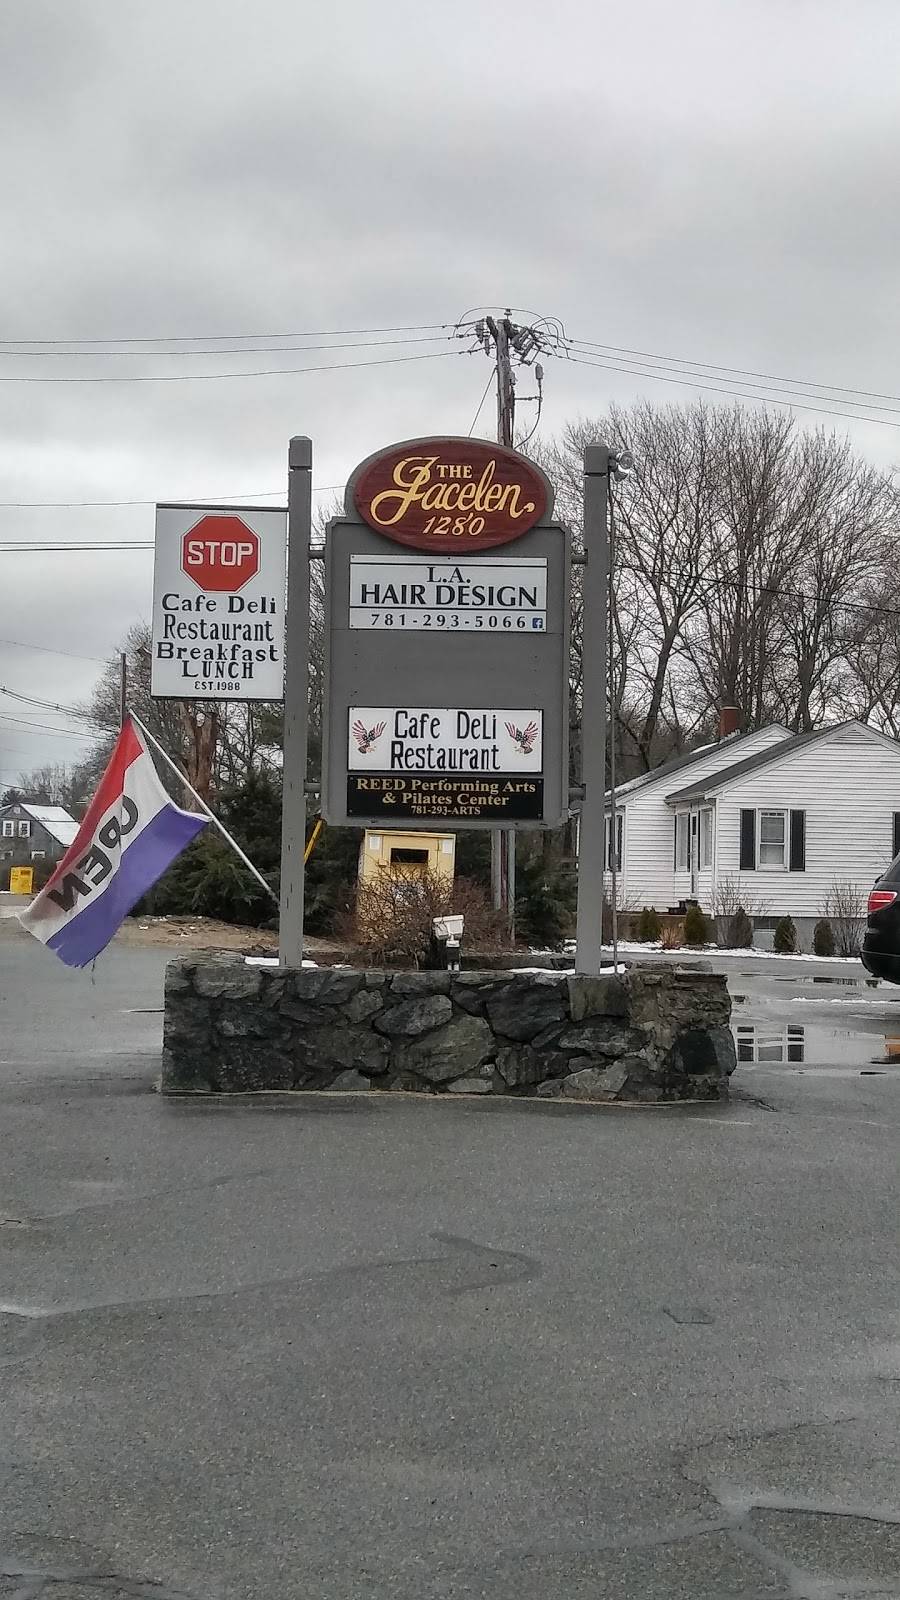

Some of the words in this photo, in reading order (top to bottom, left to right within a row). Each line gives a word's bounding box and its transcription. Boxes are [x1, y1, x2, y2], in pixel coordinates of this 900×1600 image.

[436, 464, 473, 479] THE
[423, 512, 485, 536] 1280
[187, 540, 254, 566] STOP
[426, 566, 471, 583] L.A.
[162, 593, 217, 612] Cafe
[228, 595, 276, 614] Deli
[361, 584, 427, 605] HAIR
[436, 585, 537, 607] DESIGN
[163, 613, 274, 642] Restaurant
[371, 613, 526, 629] 781-293-5066
[156, 641, 279, 662] Breakfast
[181, 660, 254, 679] LUNCH
[394, 710, 441, 739] Cafe
[391, 740, 501, 770] Restaurant
[357, 778, 406, 791] REED
[411, 778, 499, 795] Performing
[502, 781, 536, 793] Arts
[382, 792, 396, 804] &
[402, 792, 453, 805] Pilates
[457, 793, 510, 806] Center
[411, 805, 481, 816] 781-293-ARTS
